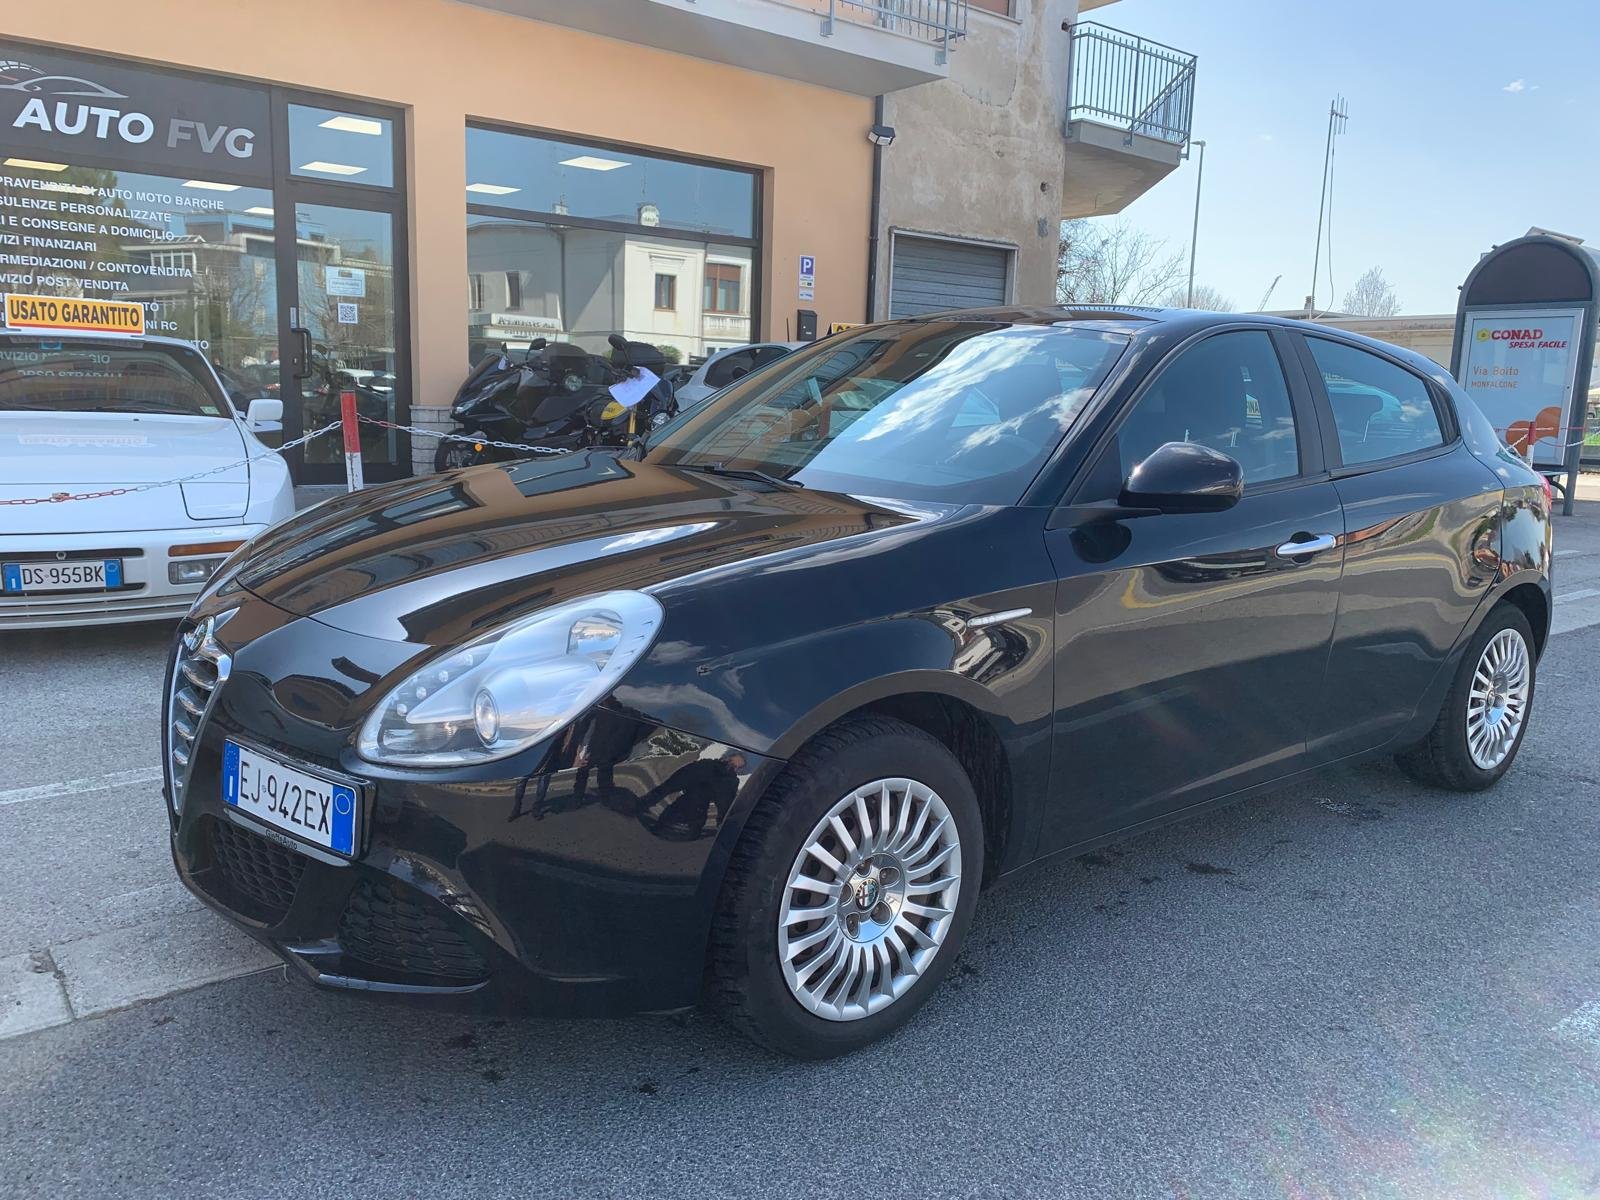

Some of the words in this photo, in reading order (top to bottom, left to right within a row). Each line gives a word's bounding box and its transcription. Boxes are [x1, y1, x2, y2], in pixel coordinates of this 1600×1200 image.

[12, 98, 154, 144] AUTO
[167, 117, 255, 159] FVG
[98, 187, 133, 200] AUTO
[136, 191, 172, 205] MOTO
[175, 196, 224, 210] BARCHE
[60, 201, 172, 222] PERSONALIZZATE
[9, 215, 18, 226] E
[21, 217, 97, 234] CONSEGNE
[99, 224, 108, 235] A
[111, 226, 175, 241] DOMICILIO
[23, 236, 97, 252] FINANZIARI
[97, 261, 193, 278] CONTOVENDITA
[803, 258, 812, 273] P
[36, 275, 72, 287] POST
[76, 278, 130, 292] VENDITA
[10, 299, 57, 322] USATO
[61, 303, 140, 327] GARANTITO
[160, 320, 178, 331] RC
[1491, 329, 1543, 341] CONAD
[1509, 341, 1535, 349] SPESA
[1538, 340, 1568, 348] FACILE
[1473, 366, 1488, 376] Via
[1471, 380, 1519, 389] MONFALCONE
